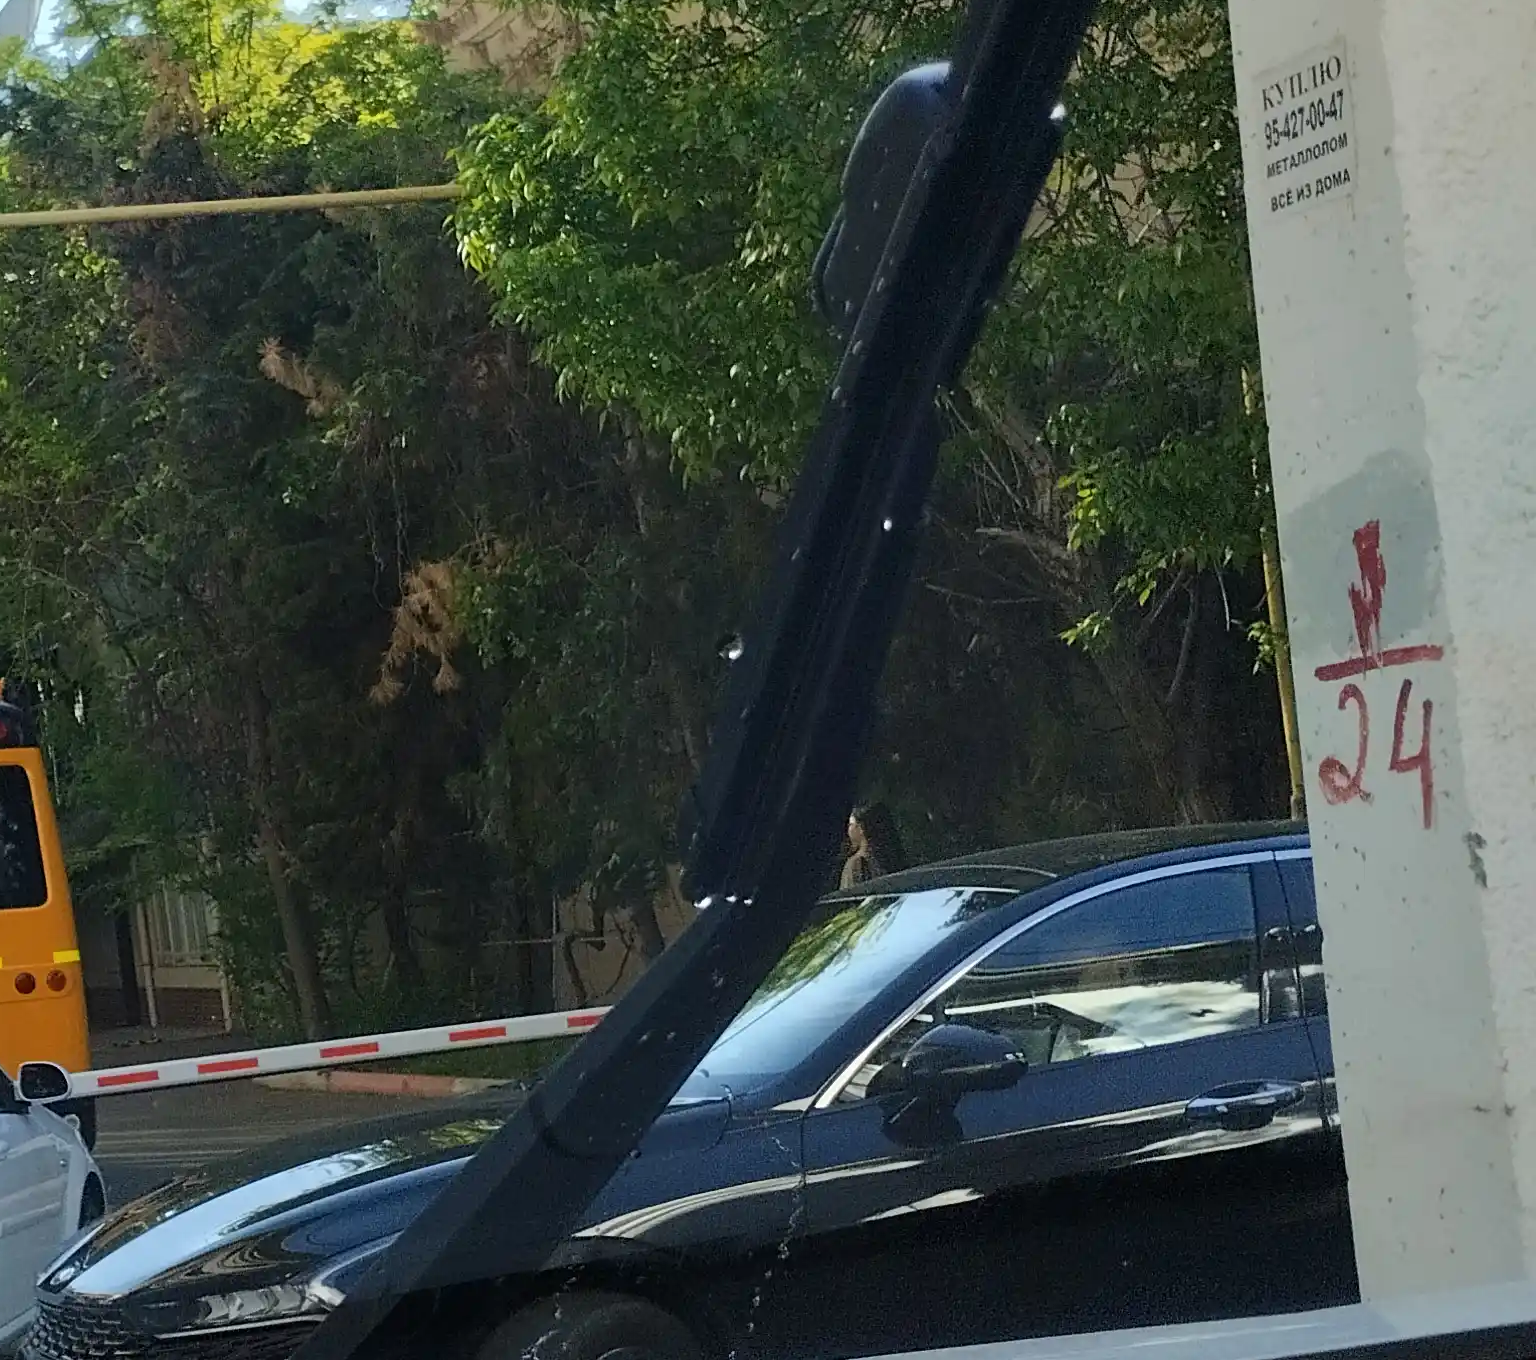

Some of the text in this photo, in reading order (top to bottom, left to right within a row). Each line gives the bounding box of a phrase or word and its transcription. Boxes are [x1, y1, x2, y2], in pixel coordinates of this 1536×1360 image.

[1262, 55, 1342, 111] КУПЛЮ
[1264, 88, 1344, 151] 95-427-00-47
[1267, 132, 1348, 179] МЕТАЛЛОЛОМ
[1296, 182, 1312, 203] ИЗ
[1316, 168, 1351, 198] ДОМА
[1318, 678, 1434, 830] 24
